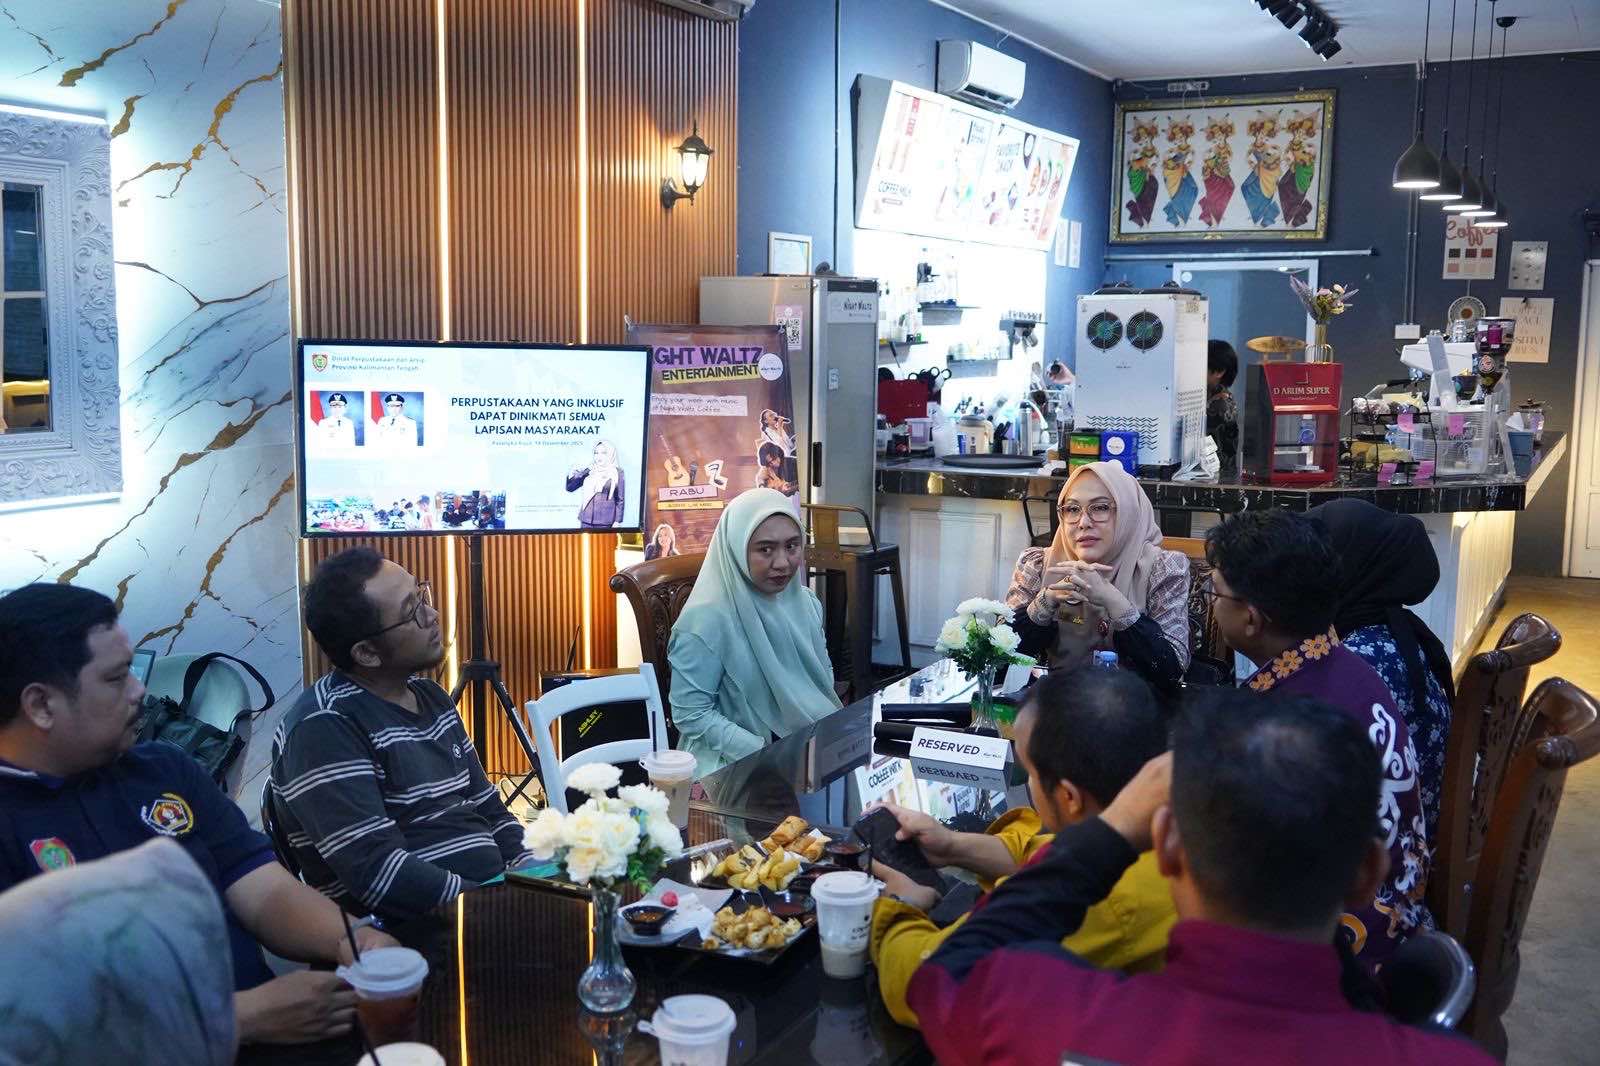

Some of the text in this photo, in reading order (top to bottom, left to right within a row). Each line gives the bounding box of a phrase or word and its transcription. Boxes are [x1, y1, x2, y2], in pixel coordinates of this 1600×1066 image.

[700, 346, 762, 364] WALTZ
[662, 364, 759, 381] ENTERTAINMENT
[1306, 386, 1330, 394] SUPER
[451, 397, 625, 408] PERPUSTAKAAN YANG INKLUSIF
[470, 411, 606, 421] DAPAT DINIKMATI SEMUA
[475, 425, 601, 435] LAPISAN MASYARAKAT
[669, 487, 705, 497] RABU
[917, 738, 980, 755] RESERVED
